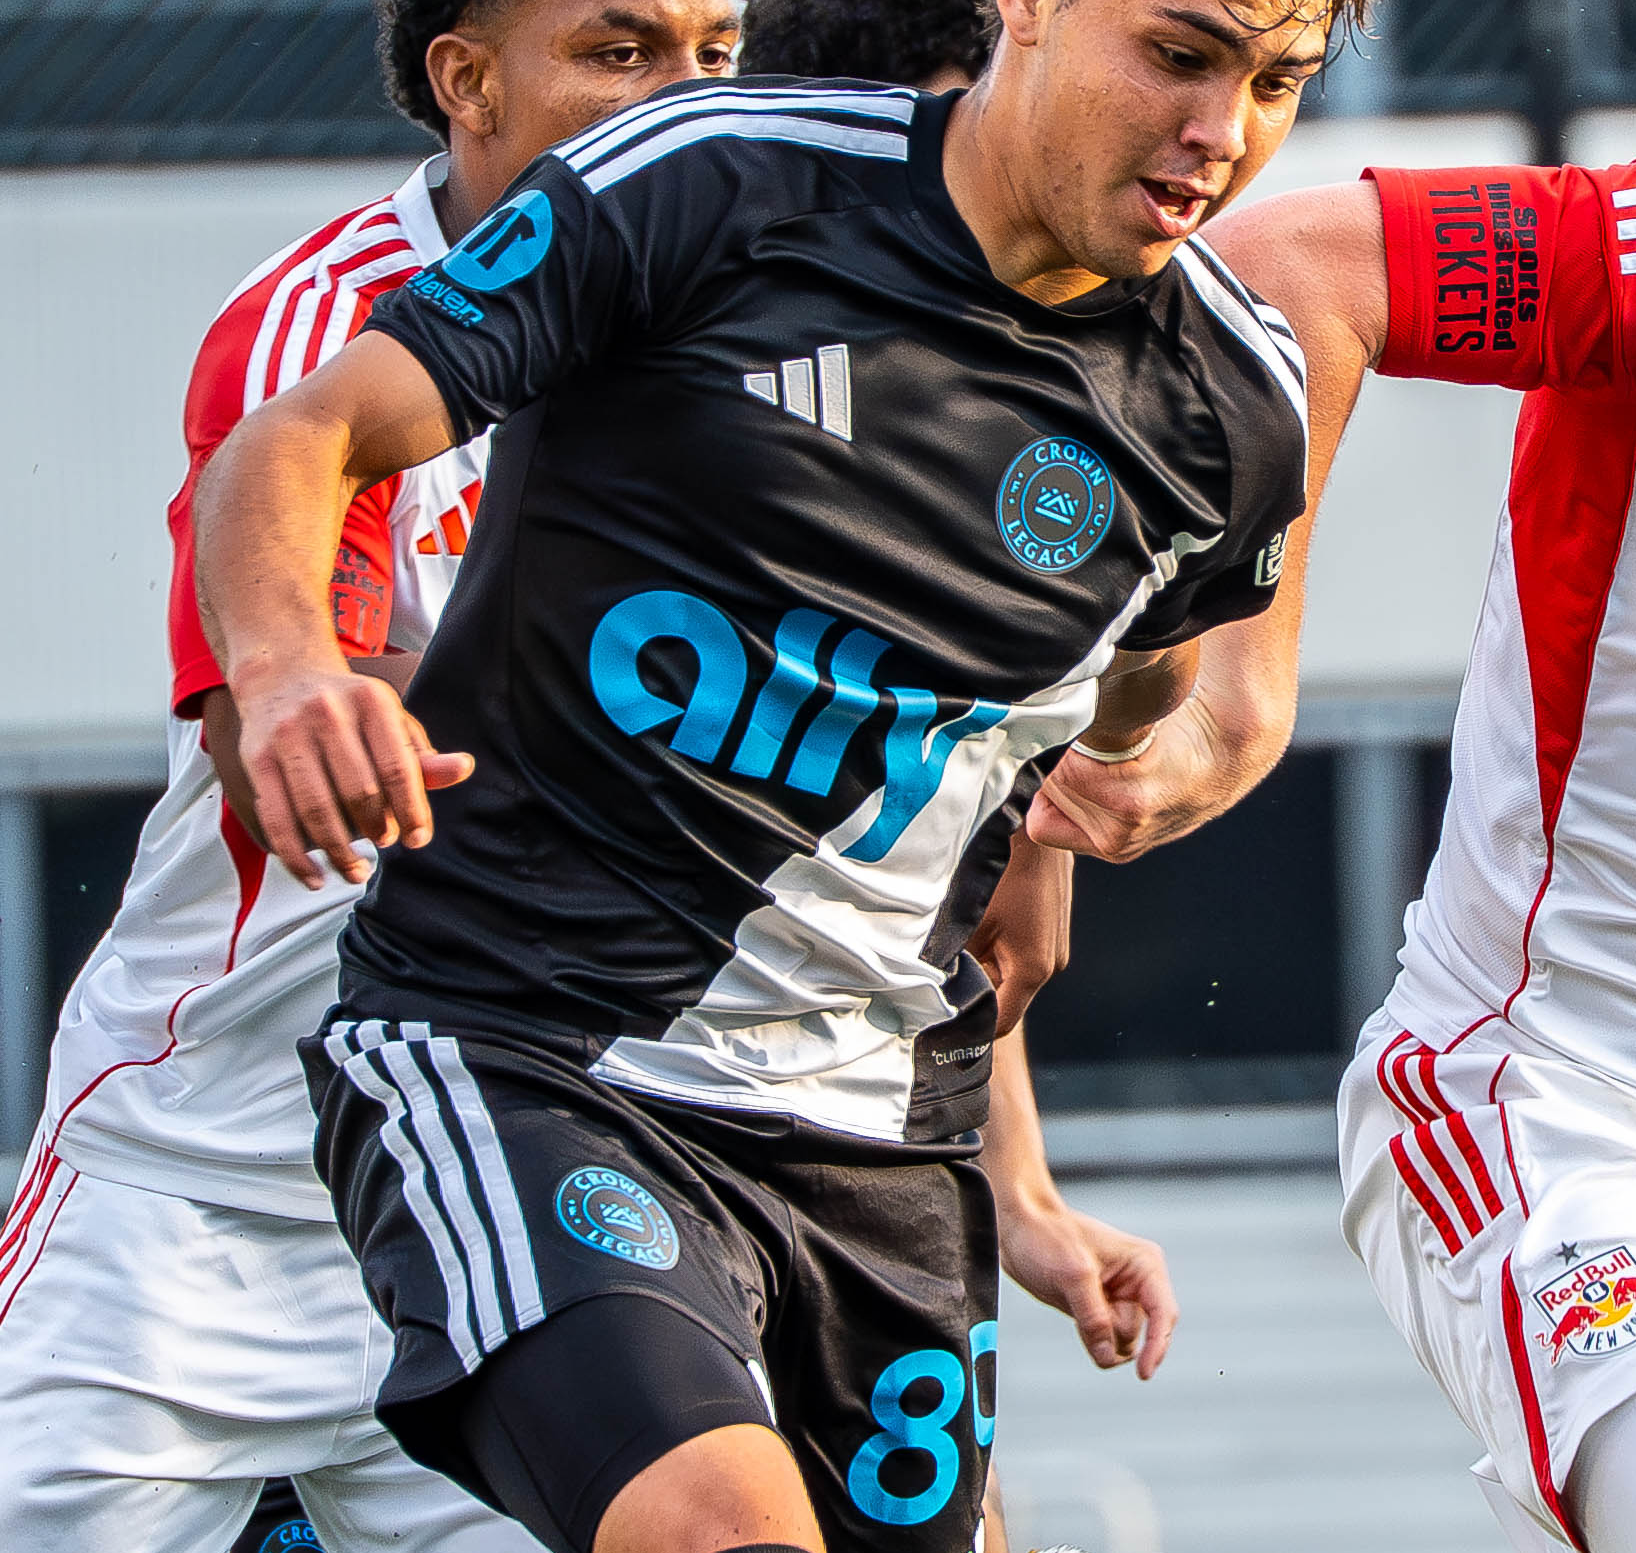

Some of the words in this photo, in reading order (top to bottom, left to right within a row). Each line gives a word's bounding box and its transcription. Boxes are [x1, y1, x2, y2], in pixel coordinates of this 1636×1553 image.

[1428, 184, 1489, 353] TICKETS
[1486, 183, 1517, 351] Illustrated
[1514, 207, 1540, 323] Sports
[1034, 442, 1106, 487] CROWN
[1006, 518, 1079, 566] LEGACY
[589, 589, 1011, 864] ally
[573, 1172, 652, 1207] CROWN
[585, 1229, 667, 1264] LEGACY
[1540, 1271, 1585, 1312] Red
[1584, 1250, 1632, 1282] Bull
[1583, 1328, 1617, 1351] NEW
[279, 1525, 317, 1545] CRO
